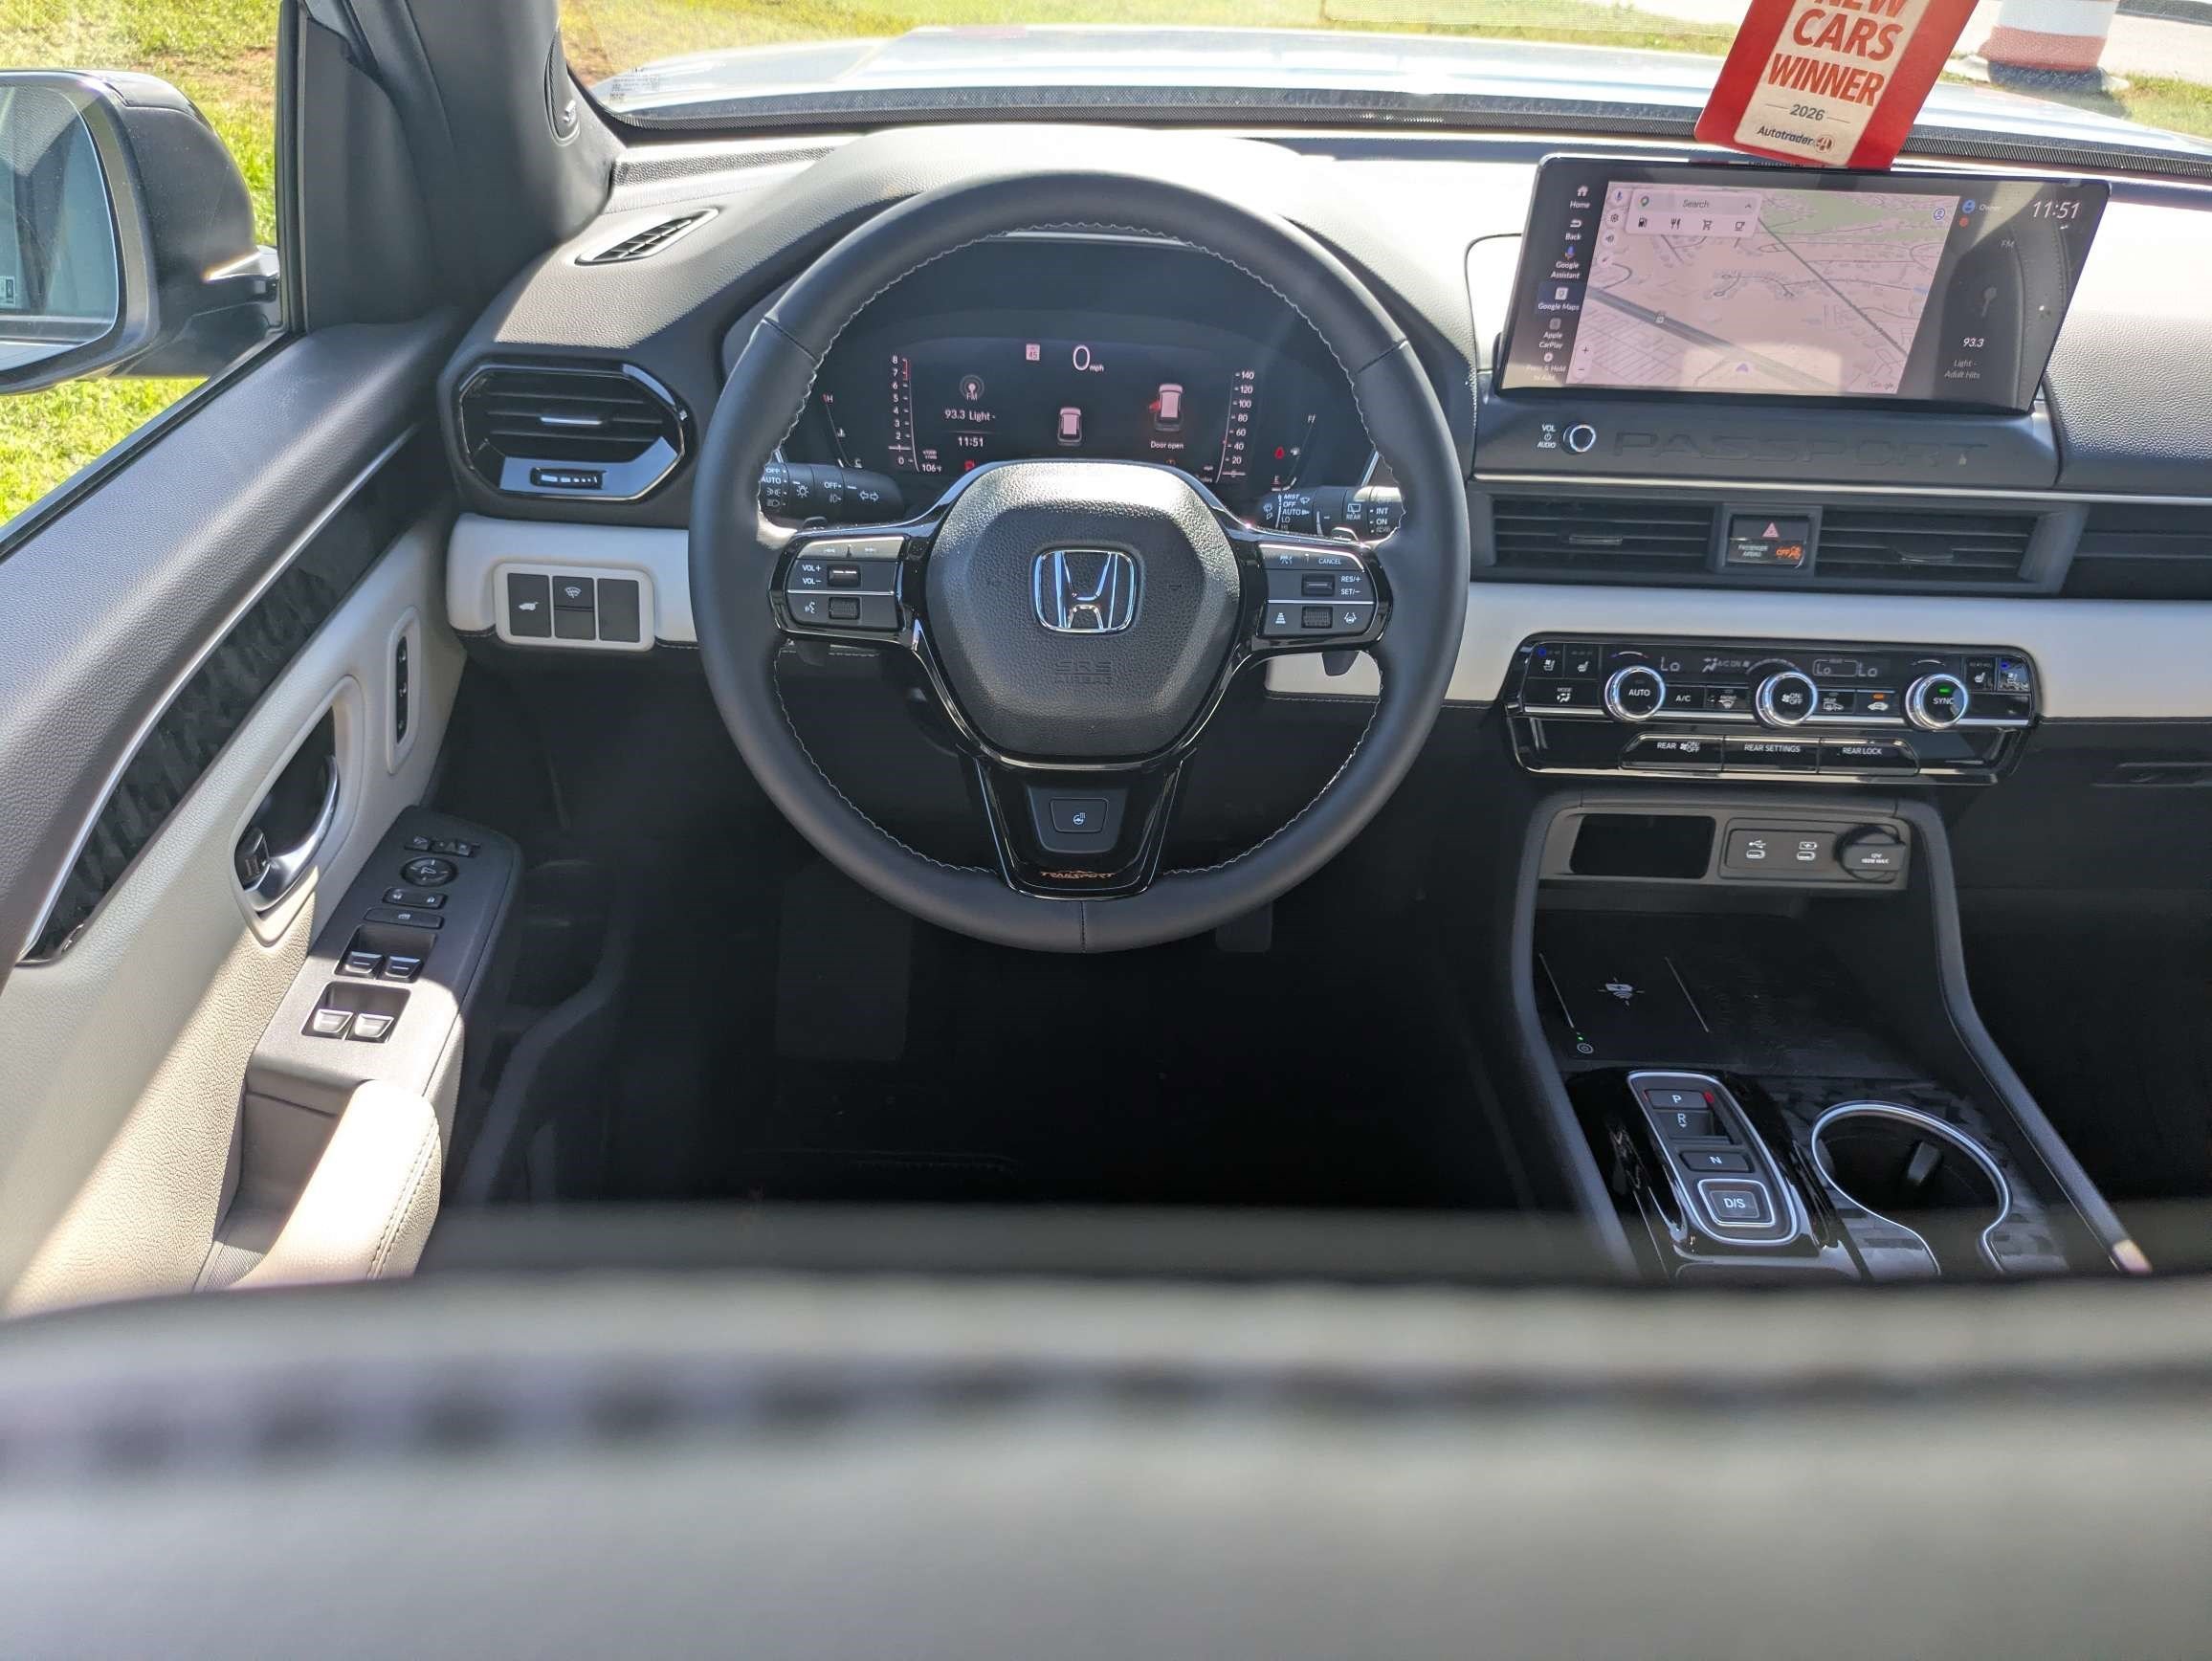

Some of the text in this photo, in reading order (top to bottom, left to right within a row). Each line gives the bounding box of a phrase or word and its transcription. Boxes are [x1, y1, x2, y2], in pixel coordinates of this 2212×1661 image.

[1793, 8, 1904, 61] CARS
[1767, 53, 1885, 107] WINNER
[1789, 103, 1825, 122] 2026
[1757, 124, 1814, 146] Autotrader
[1569, 200, 1590, 210] Home
[1682, 199, 1710, 210] Search
[2032, 200, 2081, 220] 11:51
[1564, 233, 1582, 241] Back
[1556, 260, 1580, 271] Google
[1550, 271, 1581, 279] Assistant
[1537, 302, 1580, 312] Google Maps
[1542, 331, 1563, 340] Apple
[1962, 337, 1985, 348] 93.3
[892, 355, 898, 365] 8
[1073, 344, 1091, 371] 0
[893, 368, 898, 377] 7
[1090, 365, 1104, 373] mph
[1241, 370, 1255, 380] 140
[892, 382, 898, 390] 6
[1240, 385, 1253, 394] 120
[893, 394, 899, 403] 5
[966, 392, 978, 401] FM
[1238, 400, 1252, 409] 100
[944, 409, 966, 420] 93.3
[968, 410, 990, 423] Light
[1237, 413, 1249, 423] 80
[895, 419, 900, 428] 3
[1541, 424, 1557, 432] VOL
[896, 432, 901, 440] 2
[1236, 429, 1247, 437] 60
[958, 436, 984, 447] 11:51
[1150, 440, 1184, 451] Door open
[1234, 442, 1245, 451] 40
[1612, 431, 1990, 468] PASSPORT
[1231, 455, 1242, 465] 20
[762, 476, 782, 484] AUTO
[1660, 655, 1681, 672] Lo
[1816, 662, 1832, 675] Lo
[1858, 661, 1878, 677] Lo
[1628, 688, 1651, 697] AUTO
[1656, 741, 1677, 750] REAR
[1743, 743, 1801, 754] REAR SETTINGS
[1842, 746, 1883, 756] REAR LOCK
[1040, 870, 1118, 879] TRAILSPORT
[1671, 1094, 1682, 1103] P
[1677, 1113, 1686, 1124] R
[1709, 1155, 1722, 1164] N
[1724, 1196, 1746, 1209] D/S
